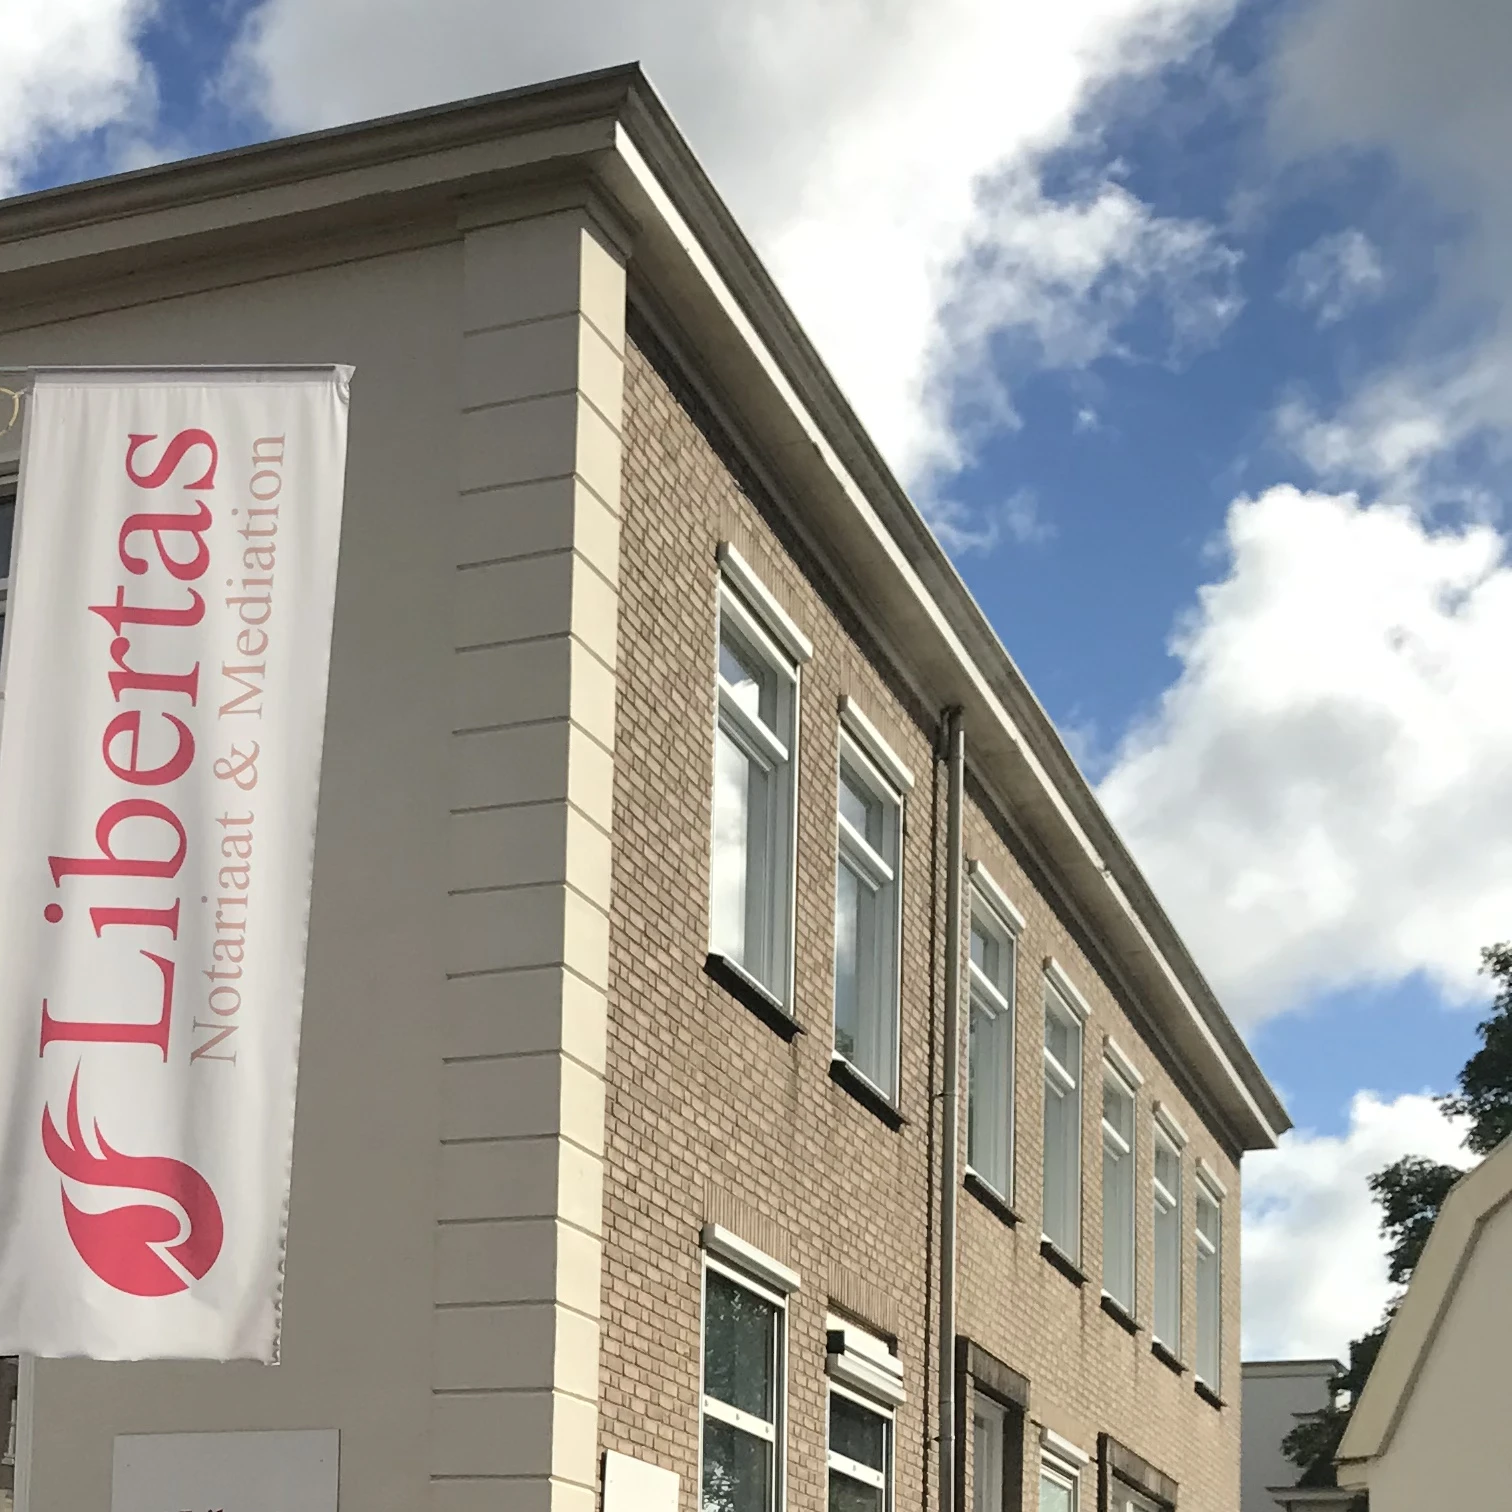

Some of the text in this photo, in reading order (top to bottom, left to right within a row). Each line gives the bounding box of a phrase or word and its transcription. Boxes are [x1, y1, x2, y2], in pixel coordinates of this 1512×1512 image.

[39, 428, 219, 1063] Libertas
[189, 432, 286, 1067] Notariaat & Mediation
